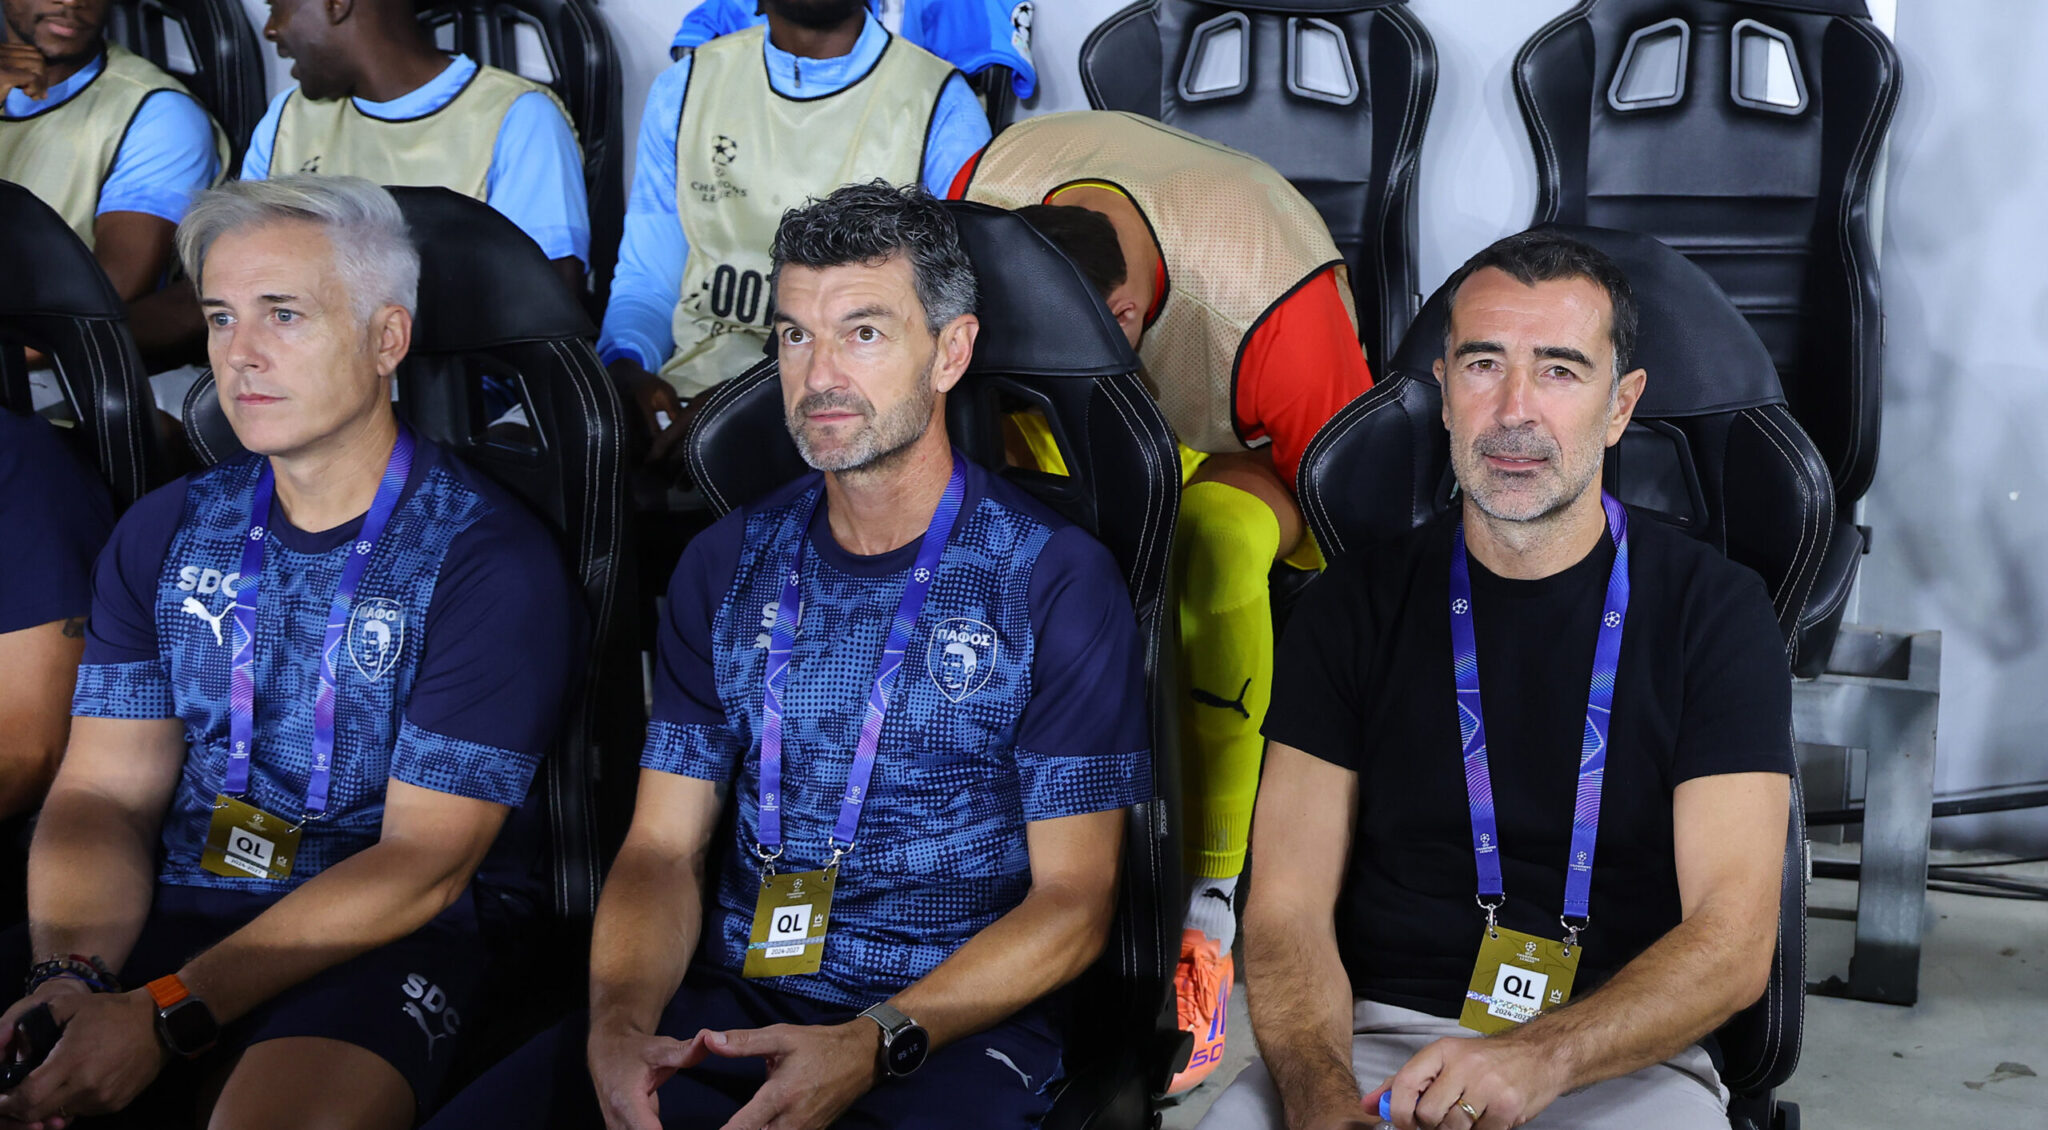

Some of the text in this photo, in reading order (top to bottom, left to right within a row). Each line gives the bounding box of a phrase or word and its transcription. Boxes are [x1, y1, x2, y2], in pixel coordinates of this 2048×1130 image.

[177, 565, 240, 599] SDC
[937, 628, 991, 647] ΠΑΦΟΣ
[236, 836, 265, 860] QL
[777, 913, 803, 934] QL
[1503, 975, 1536, 1000] QL
[401, 972, 461, 1035] SDC
